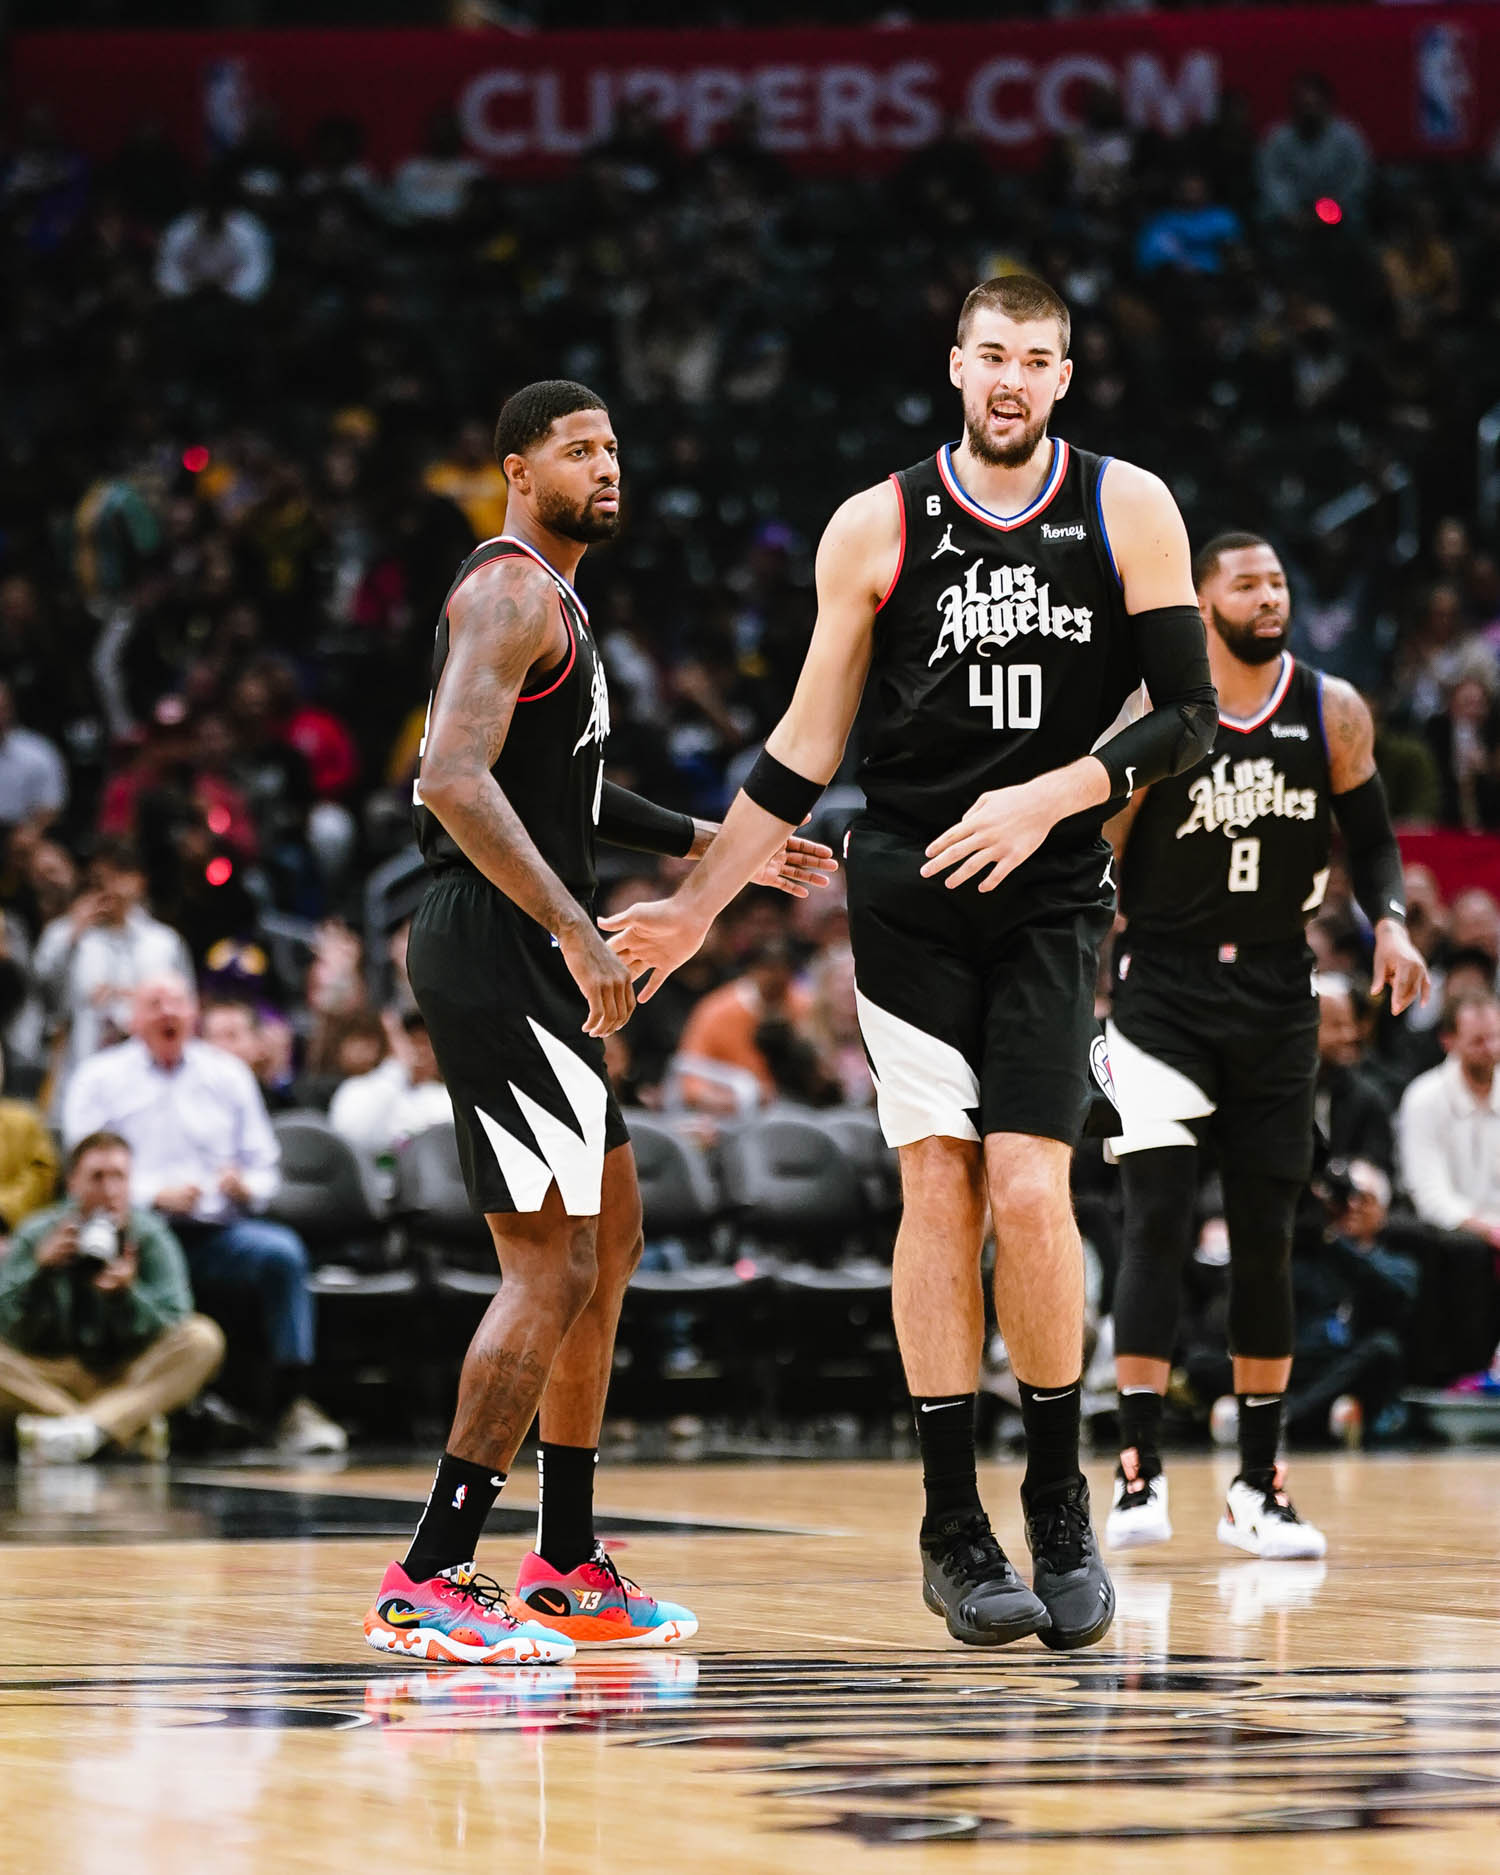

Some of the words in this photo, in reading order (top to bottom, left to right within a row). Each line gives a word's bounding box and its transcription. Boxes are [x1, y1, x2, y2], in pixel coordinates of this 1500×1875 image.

[926, 495, 941, 516] 6
[1041, 524, 1087, 541] honey
[962, 558, 1037, 606] Los
[928, 583, 1093, 667] Angeles
[969, 664, 1041, 729] 40
[1211, 754, 1274, 796] Los
[1176, 772, 1317, 839] Angeles
[1228, 837, 1260, 892] 8
[579, 1591, 603, 1610] 13
